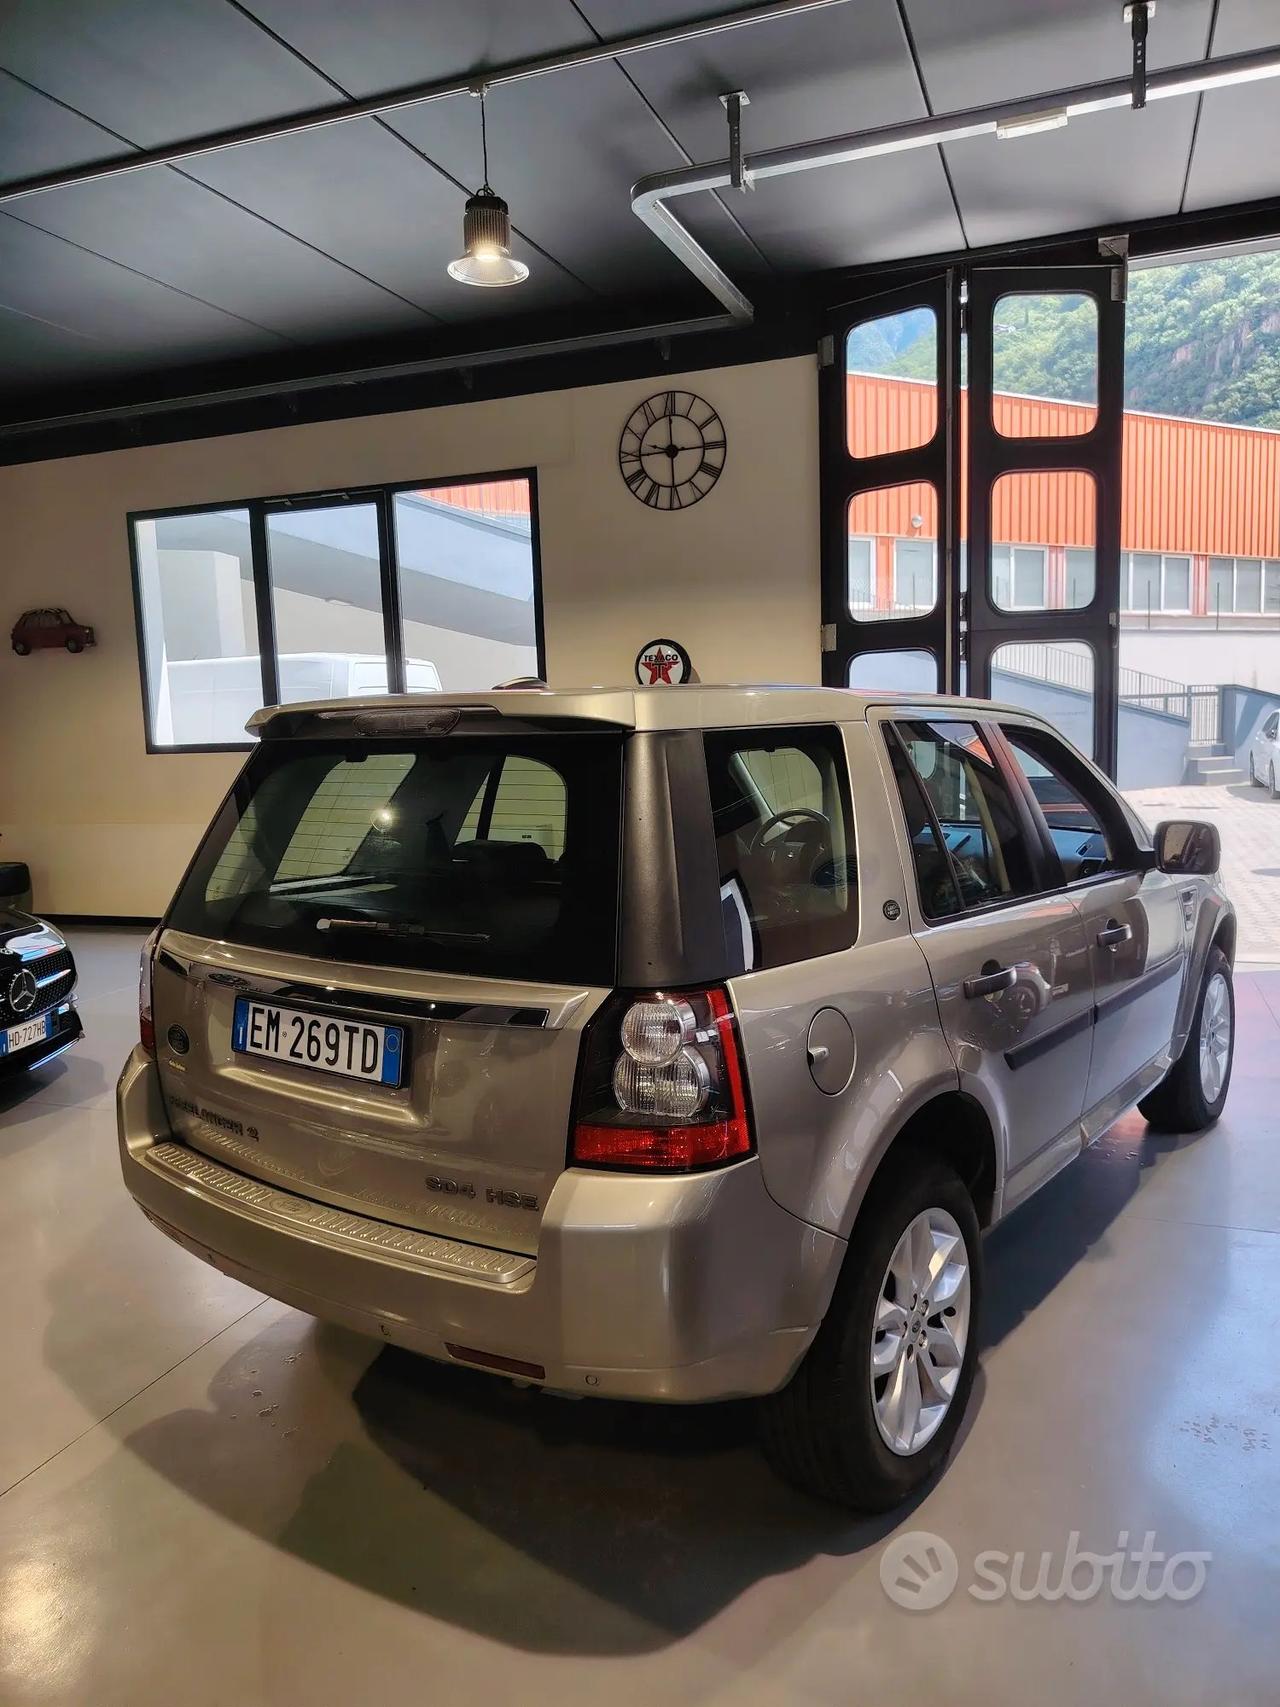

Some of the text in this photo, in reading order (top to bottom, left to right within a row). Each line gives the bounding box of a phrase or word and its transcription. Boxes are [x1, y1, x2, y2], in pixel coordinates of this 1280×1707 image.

[643, 654, 679, 663] TEXACO
[250, 1006, 281, 1053] EM
[289, 1016, 379, 1074] 269TD
[425, 1175, 540, 1212] SD4 HSE
